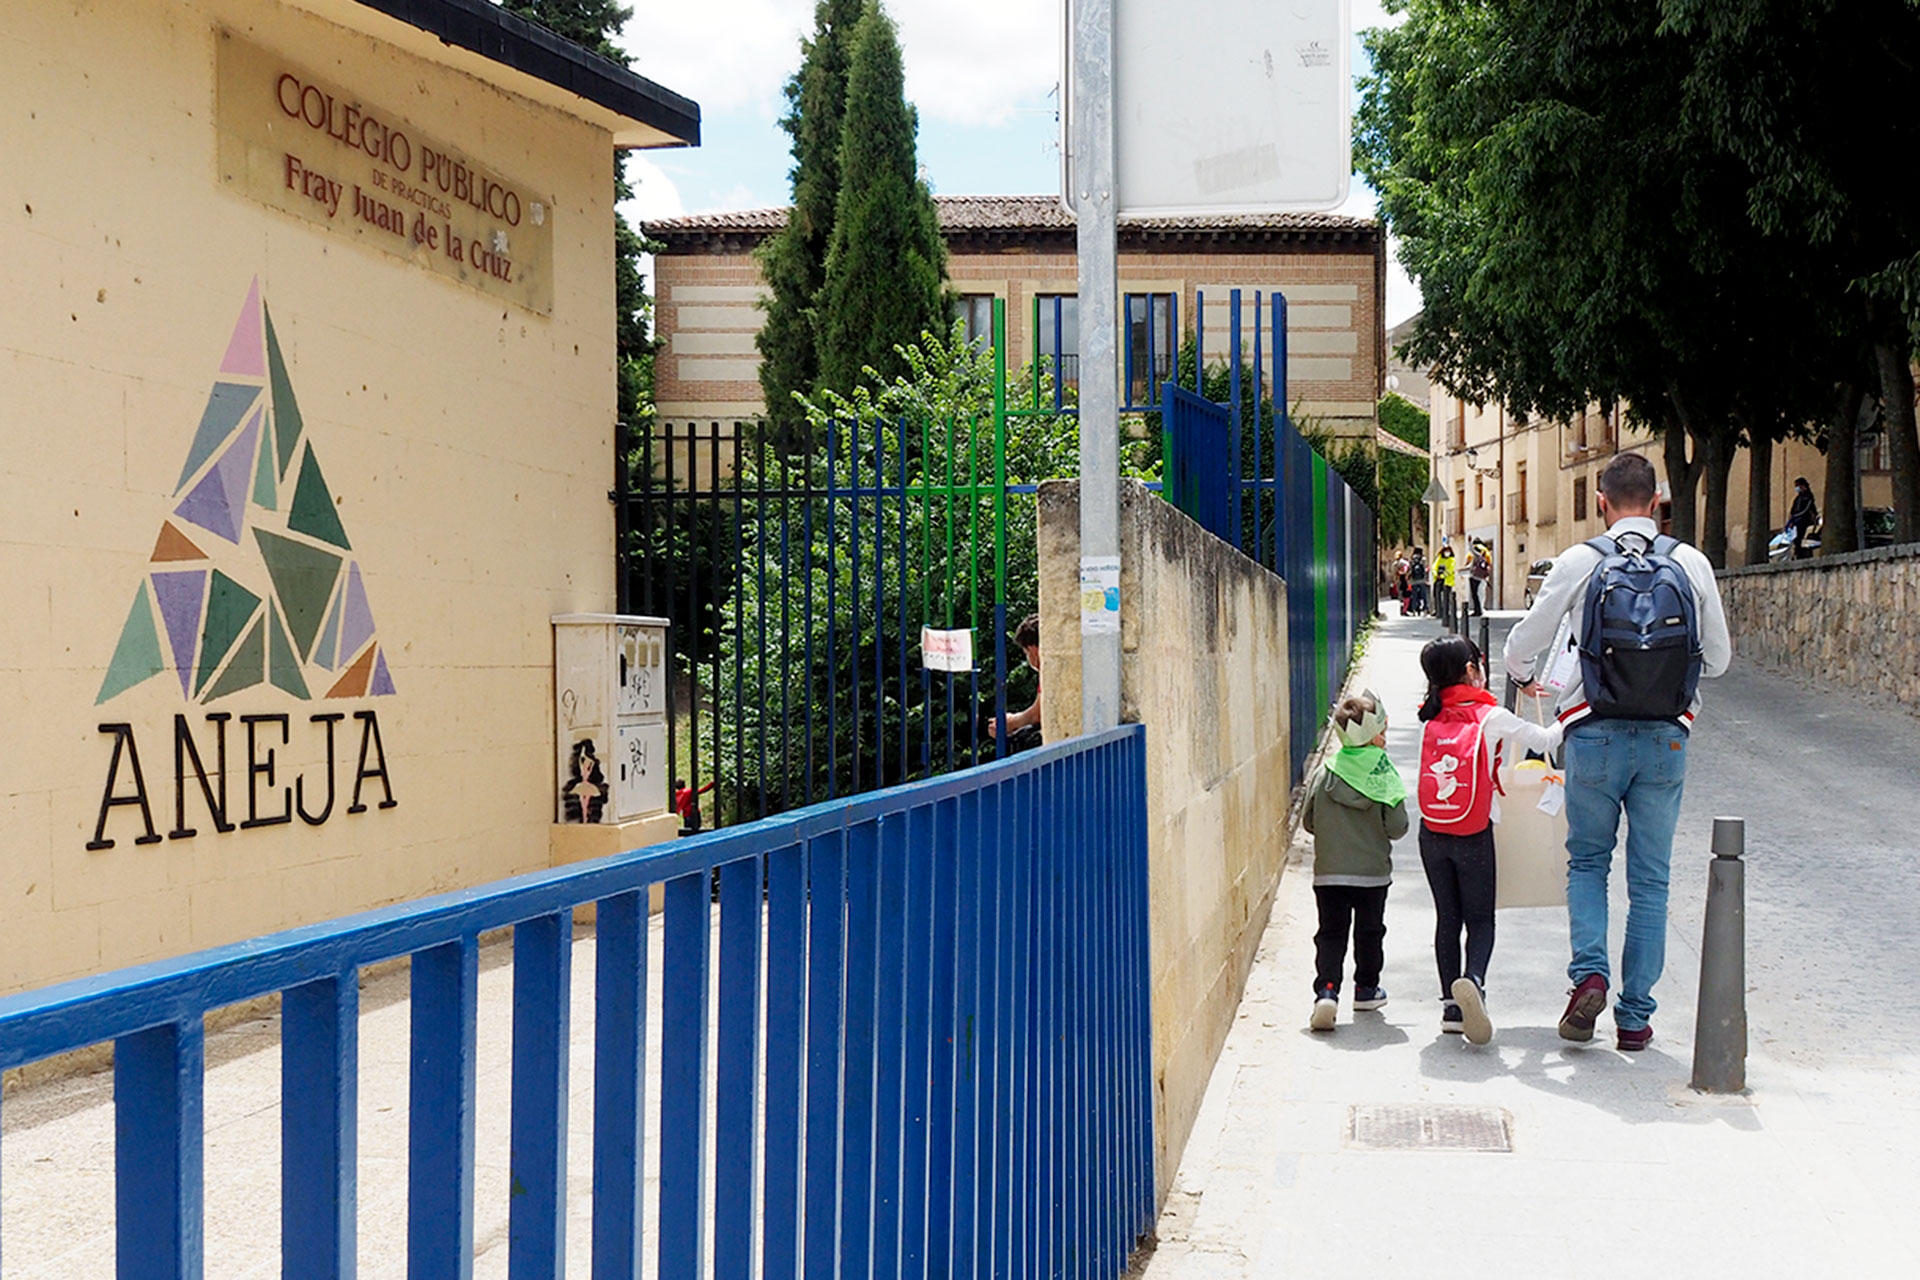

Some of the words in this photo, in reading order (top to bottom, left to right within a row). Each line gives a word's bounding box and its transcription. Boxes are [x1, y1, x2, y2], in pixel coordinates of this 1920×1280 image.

[277, 73, 411, 172] COLEGIO
[422, 146, 521, 226] PÚBLICO
[372, 168, 388, 191] DE
[284, 153, 343, 218] Fray
[353, 184, 405, 237] Juan
[413, 212, 438, 250] de
[445, 224, 464, 262] la
[471, 240, 512, 283] Cruz
[85, 710, 398, 851] ANEJA
